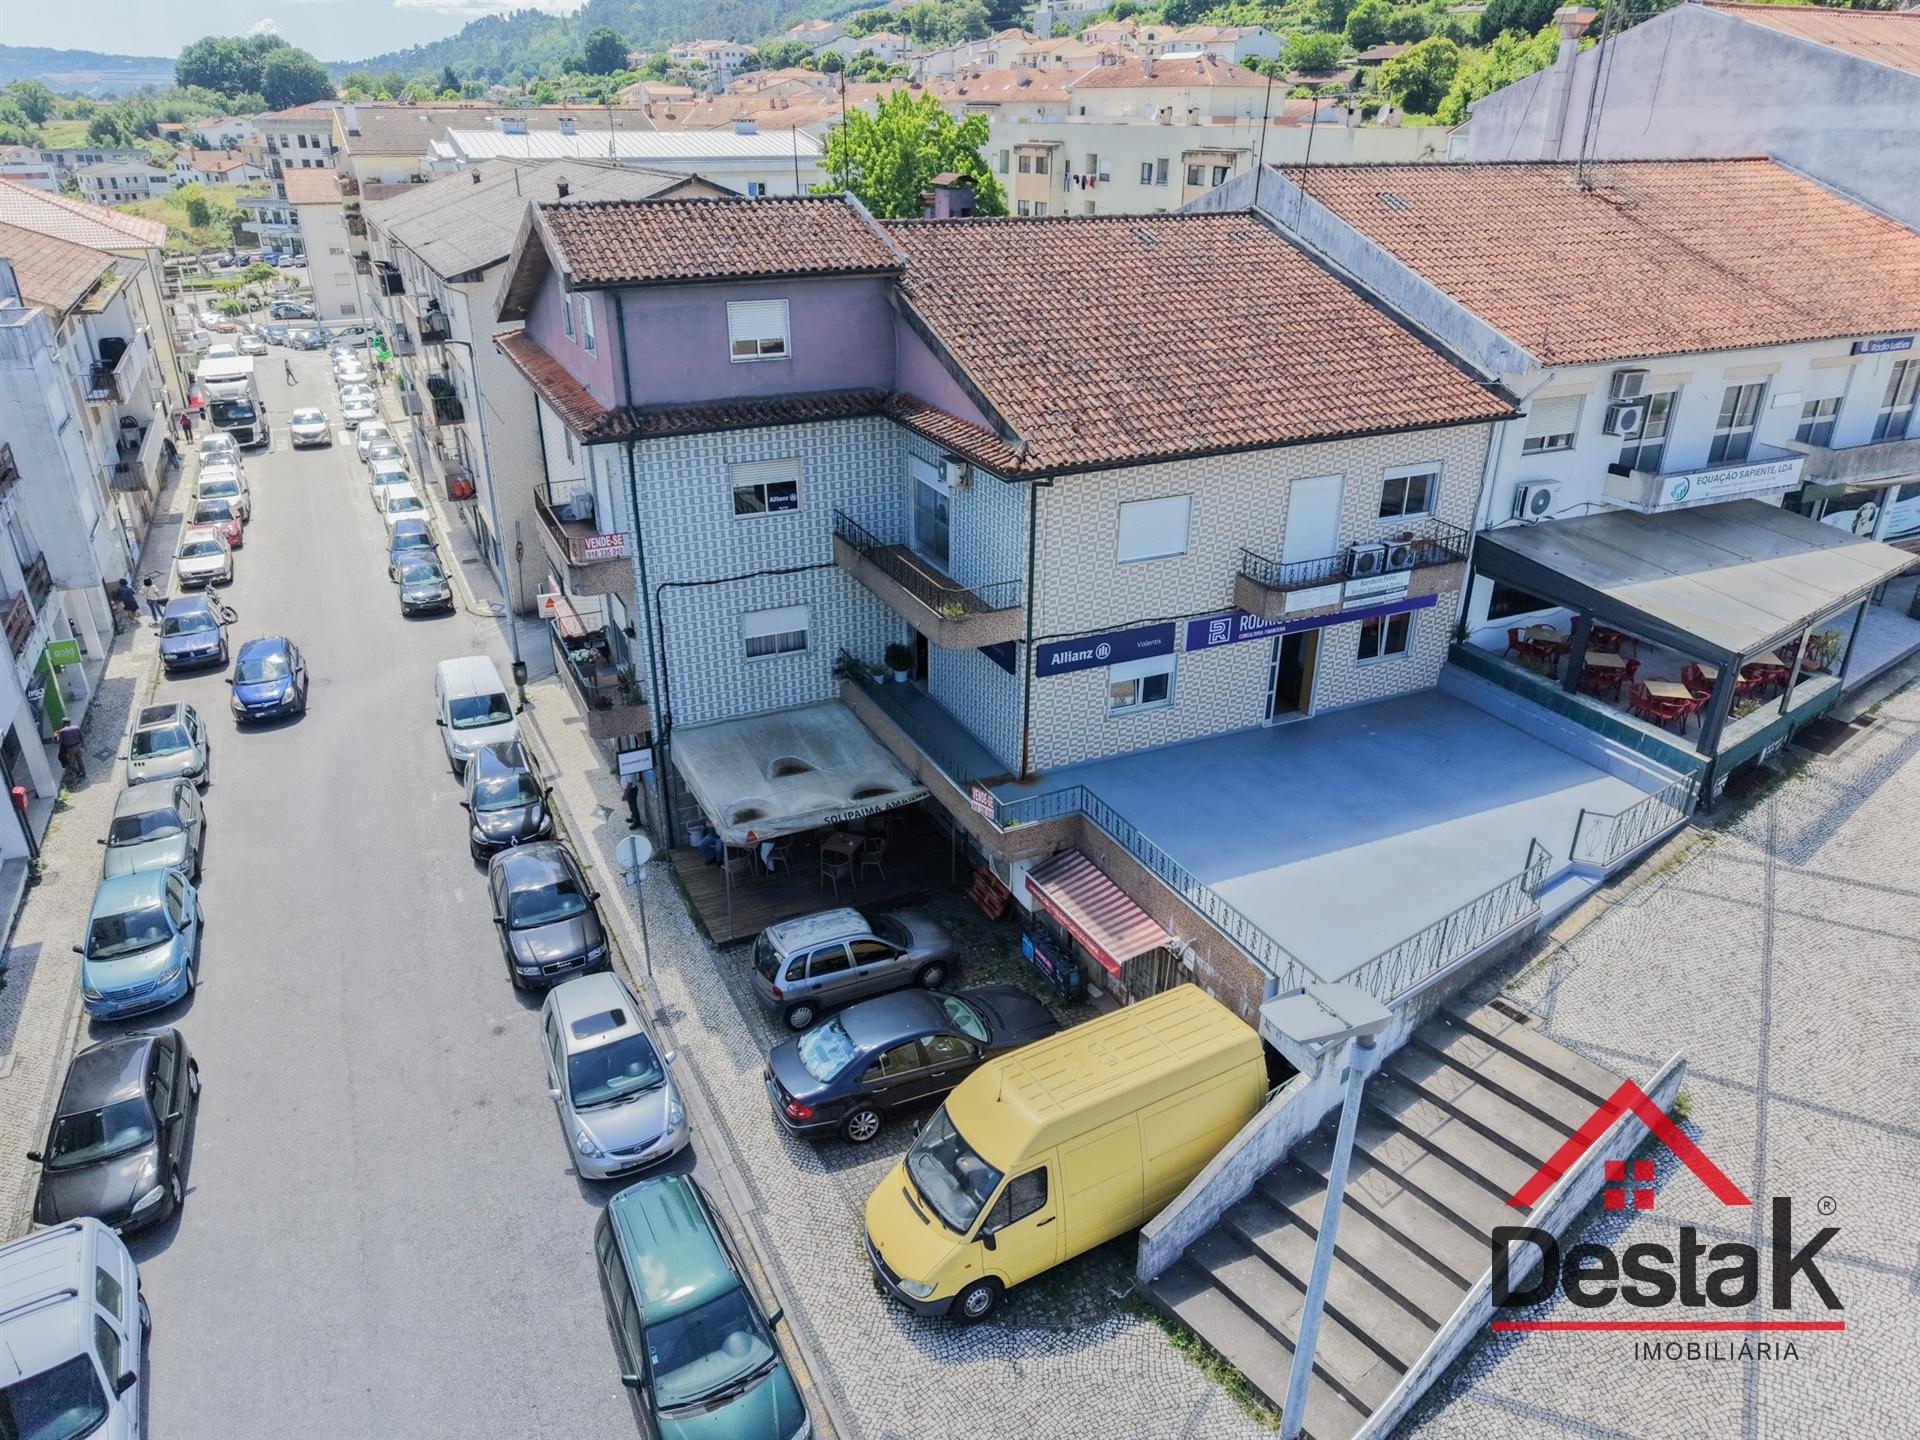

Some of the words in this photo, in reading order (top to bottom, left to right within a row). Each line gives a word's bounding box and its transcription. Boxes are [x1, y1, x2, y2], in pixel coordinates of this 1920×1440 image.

[1696, 471, 1738, 485] EQUAÇÃO
[1739, 466, 1776, 479] SAPIENTE,
[1778, 464, 1793, 473] LDA
[769, 495, 789, 503] Allianz
[585, 534, 623, 549] VENDE-SE
[1051, 649, 1093, 665] Allianz
